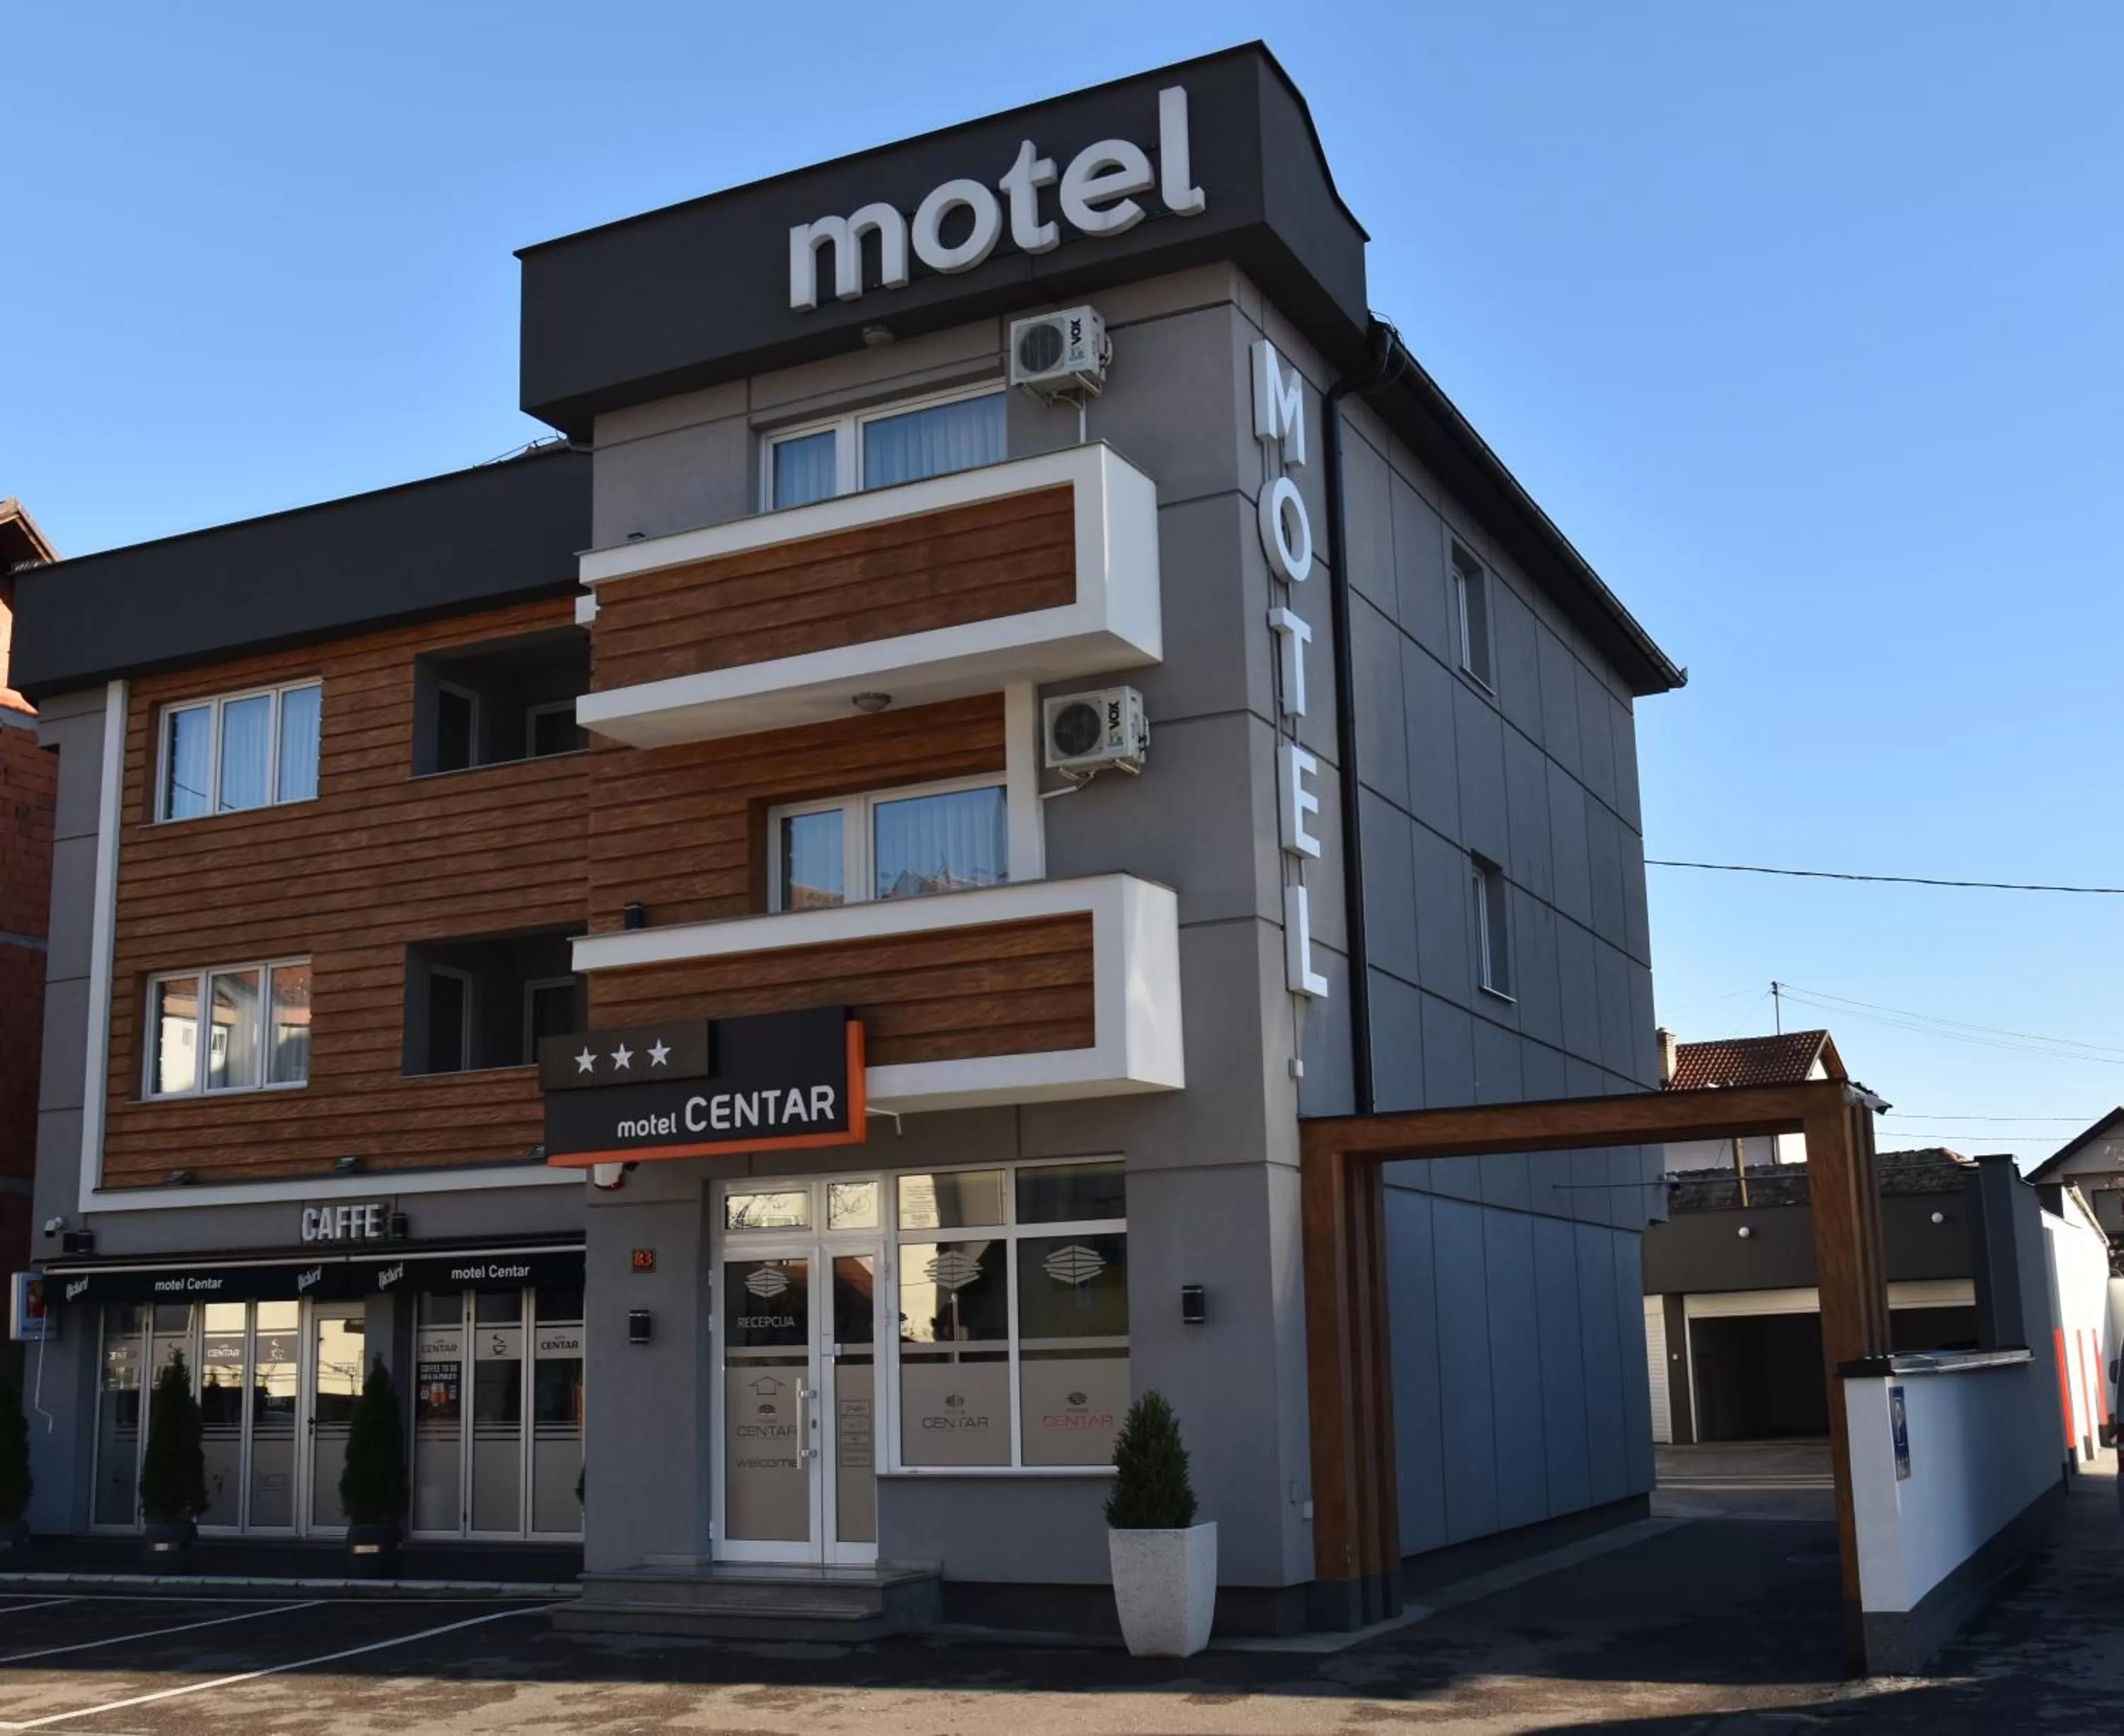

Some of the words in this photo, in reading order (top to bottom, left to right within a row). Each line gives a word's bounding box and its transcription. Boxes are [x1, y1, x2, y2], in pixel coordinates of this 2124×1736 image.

[790, 85, 1206, 312] motel
[1070, 316, 1082, 346] VOX
[1251, 339, 1328, 999] MOTEL
[1108, 699, 1120, 730] VOX
[617, 1112, 677, 1138] motel
[685, 1085, 835, 1132] CENTAR
[302, 1204, 381, 1241] CAFFE
[154, 1278, 184, 1291] motel
[187, 1277, 223, 1290] Centar
[451, 1266, 486, 1280] motel
[489, 1264, 530, 1278] Centar
[737, 1315, 796, 1328] RECEPCIJA
[541, 1340, 578, 1351] CENTAR
[923, 1416, 989, 1429] CENTAR
